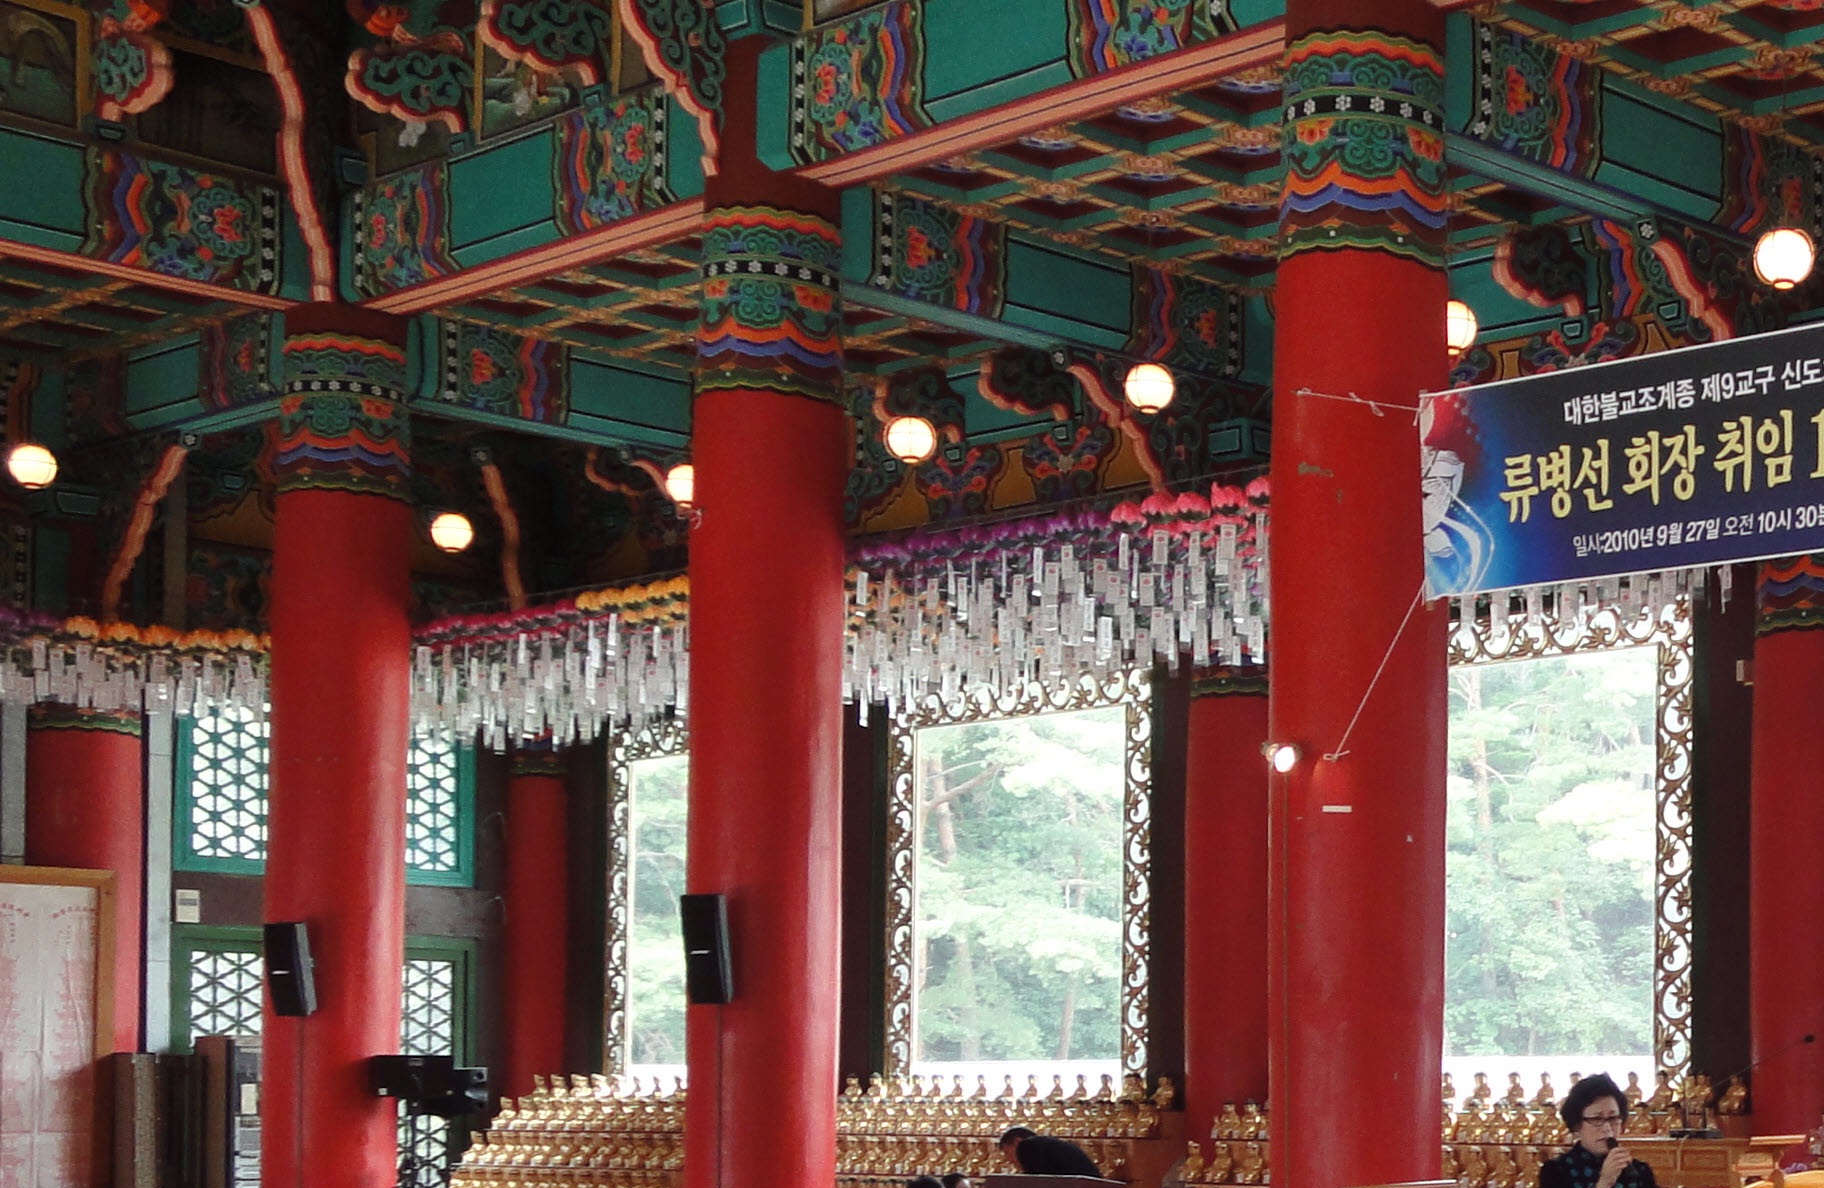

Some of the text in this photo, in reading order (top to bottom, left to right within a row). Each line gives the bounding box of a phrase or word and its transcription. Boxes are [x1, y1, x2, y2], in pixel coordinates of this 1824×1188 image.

[1563, 378, 1697, 426] 대한불교조계종
[1700, 365, 1776, 403] 제9교구
[1499, 437, 1614, 523] 류병선
[1622, 424, 1706, 506] 회장
[1713, 409, 1794, 493] 취임
[1572, 525, 1655, 558] 일시:2010년
[1656, 521, 1684, 545] 9월
[1685, 517, 1721, 543] 27일
[1723, 513, 1754, 537] 오전
[1757, 507, 1792, 533] 10시
